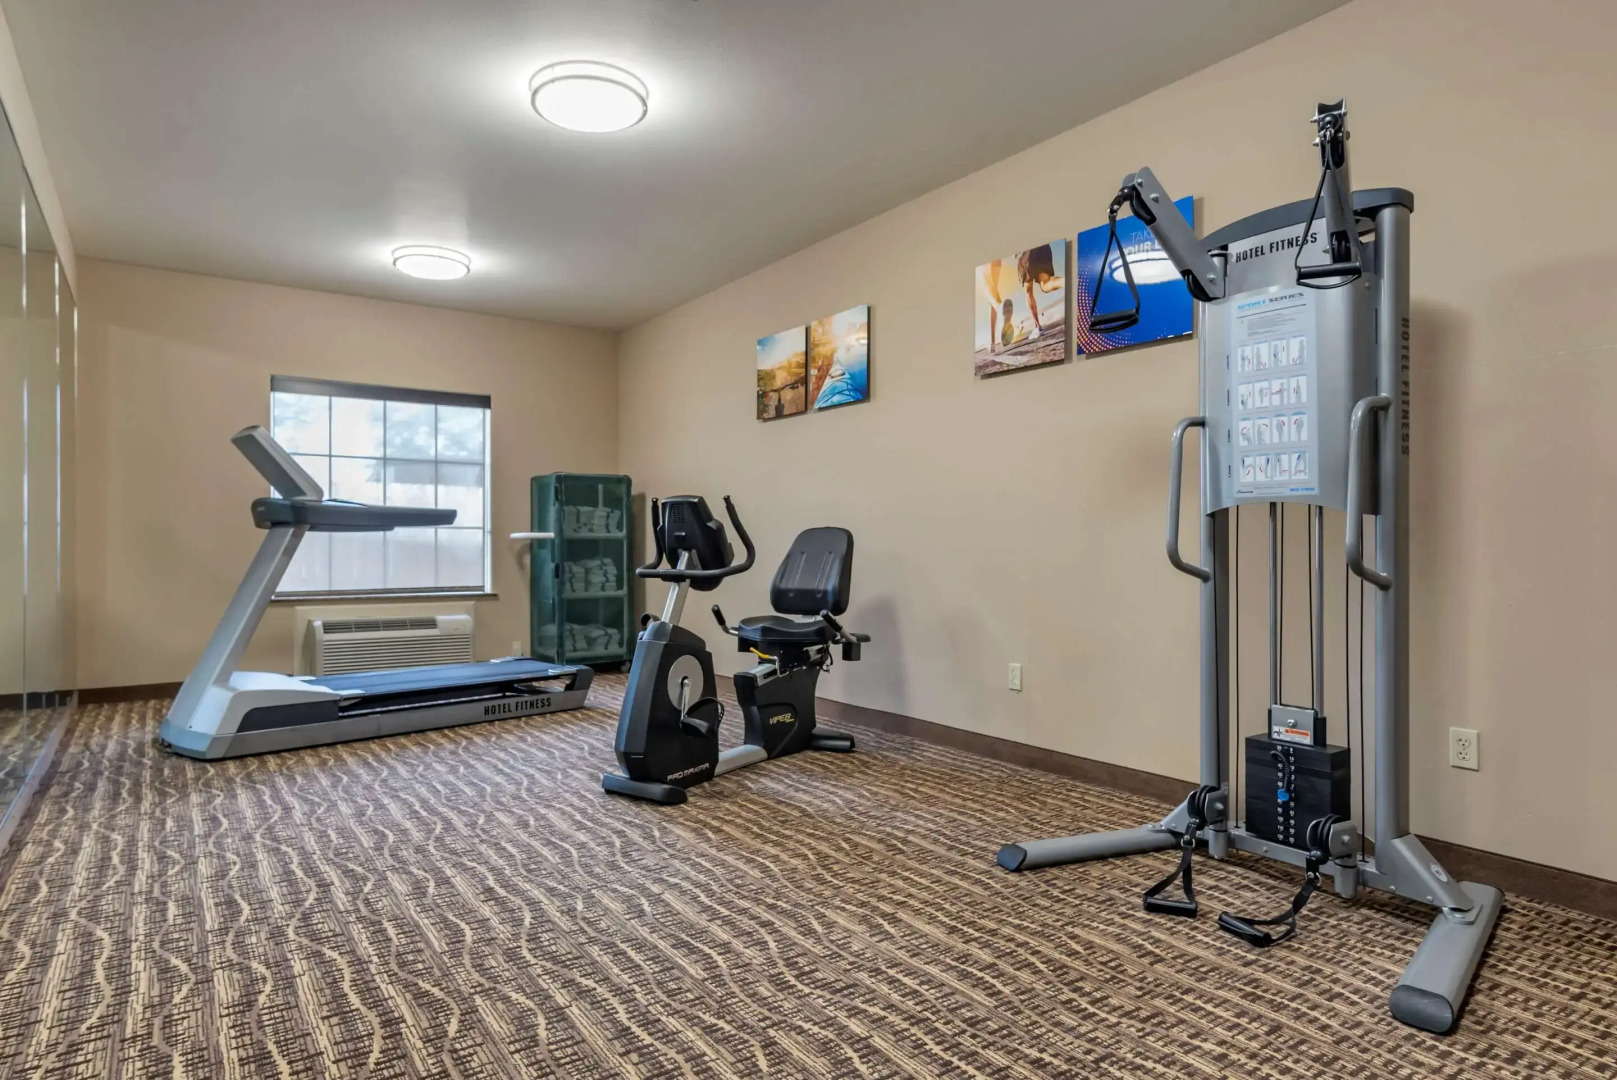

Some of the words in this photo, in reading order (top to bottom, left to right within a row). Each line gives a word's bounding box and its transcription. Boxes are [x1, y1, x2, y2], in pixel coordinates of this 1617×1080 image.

[1235, 245, 1266, 263] HOTEL
[1269, 232, 1318, 254] FITNESS
[1401, 316, 1410, 373] HOTEL
[1401, 380, 1410, 456] FITNESS
[484, 702, 512, 716] HOTEL
[515, 697, 552, 712] FITNESS
